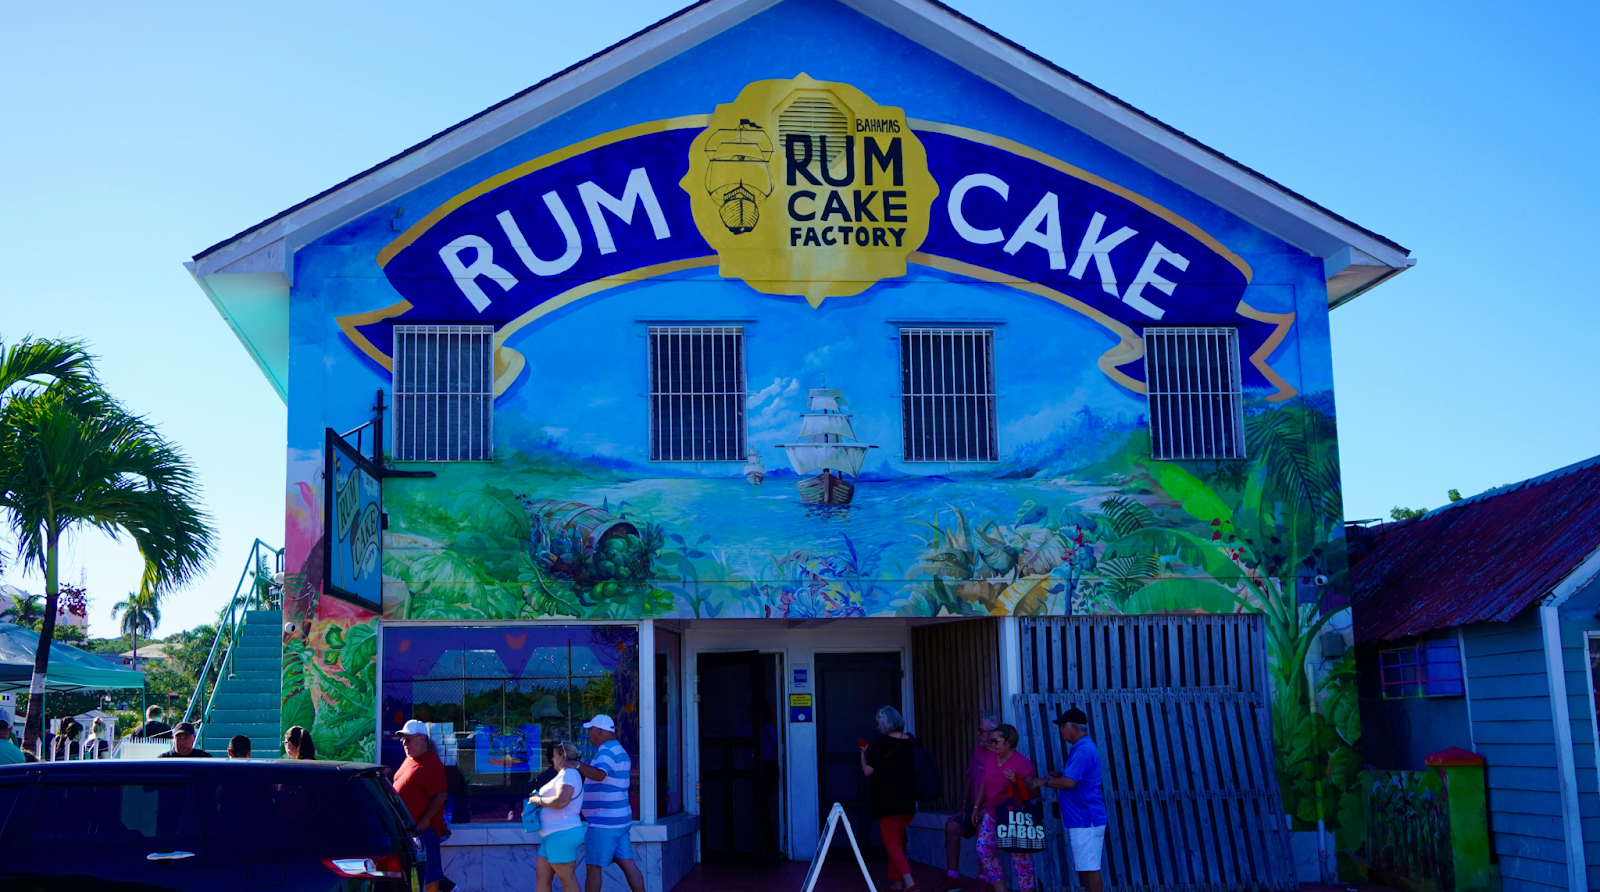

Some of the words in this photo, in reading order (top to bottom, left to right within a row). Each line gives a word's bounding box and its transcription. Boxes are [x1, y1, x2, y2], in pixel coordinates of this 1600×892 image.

[856, 118, 900, 133] BAHAMAS
[785, 133, 904, 187] RUM
[787, 190, 908, 223] CAKE
[438, 167, 672, 313] RUM
[948, 172, 1190, 320] CAKE
[790, 226, 907, 247] FACTORY
[339, 476, 358, 532] RUM
[353, 509, 377, 565] CAKE
[996, 824, 1045, 840] CABOS
[1008, 811, 1033, 826] LOS
